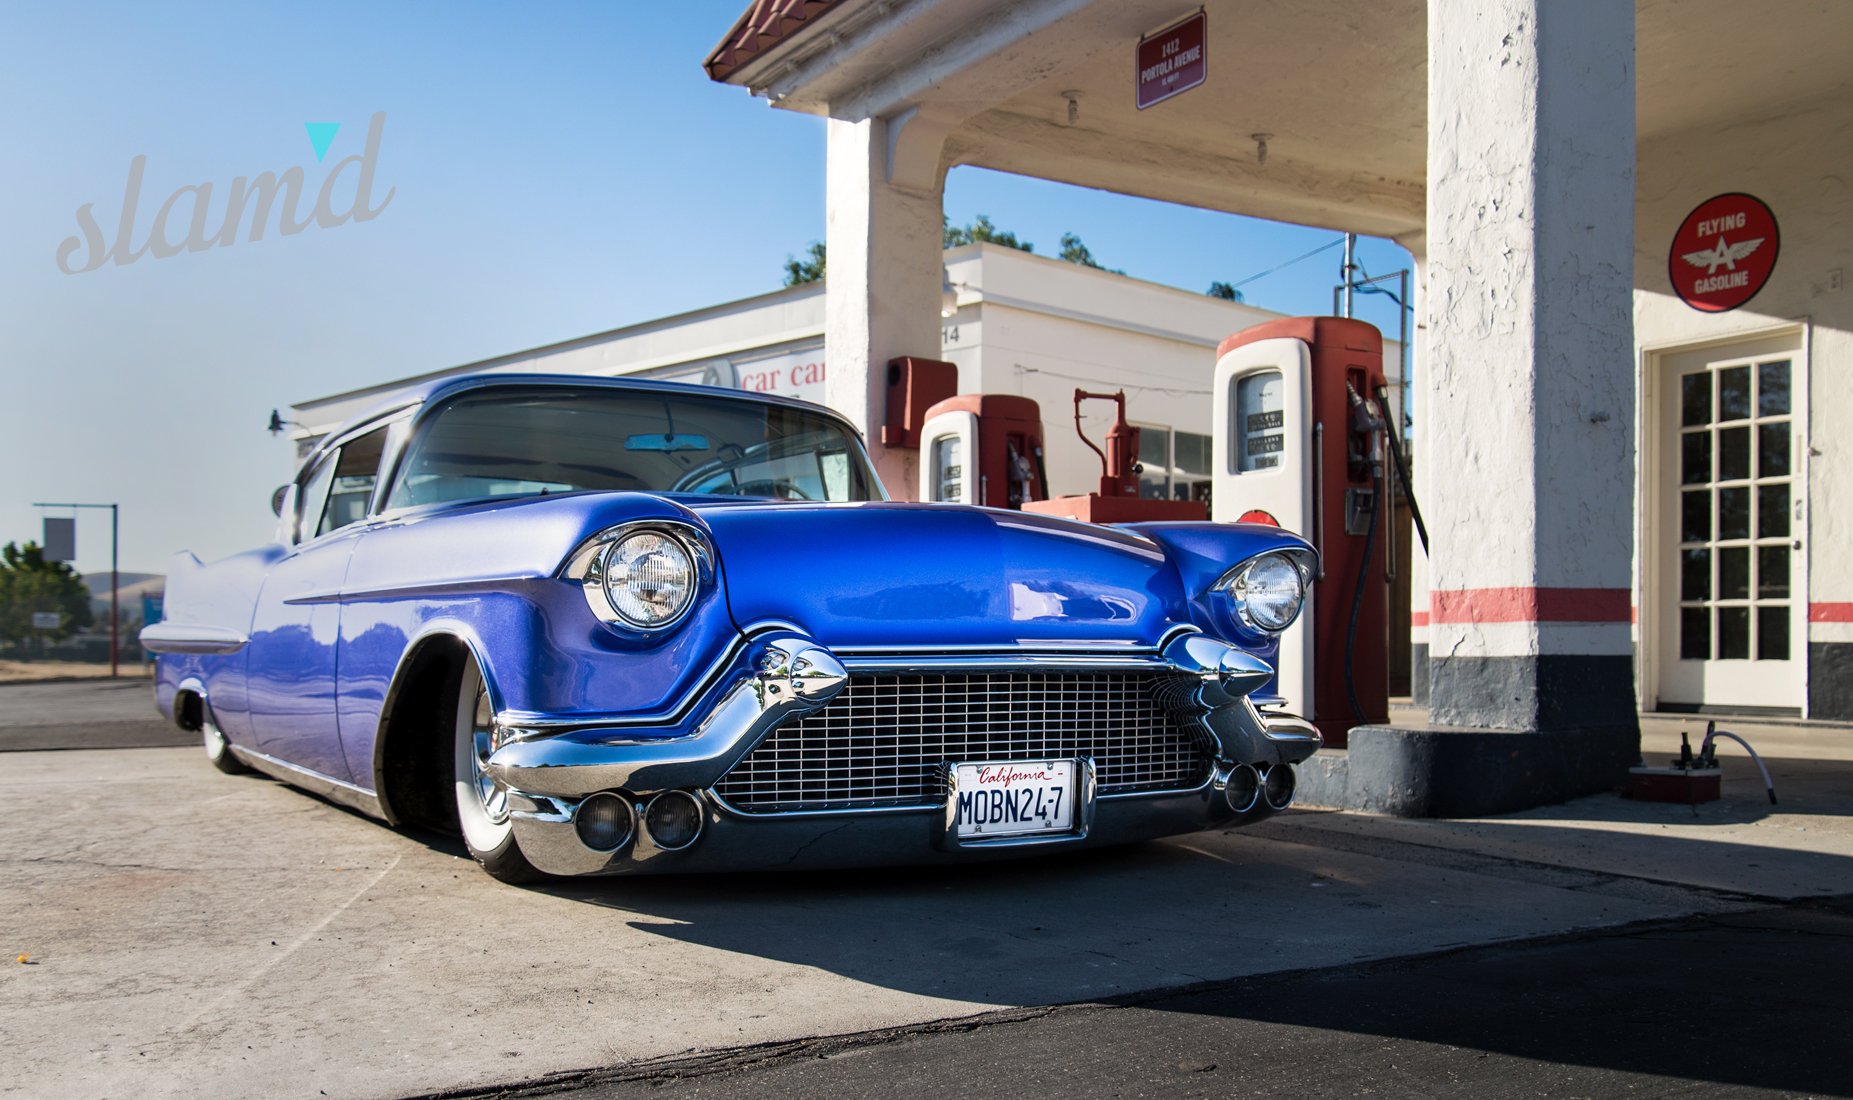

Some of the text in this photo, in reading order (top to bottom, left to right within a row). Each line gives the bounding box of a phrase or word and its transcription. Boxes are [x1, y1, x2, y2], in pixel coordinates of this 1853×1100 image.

[1162, 38, 1180, 58] 1412
[1141, 58, 1173, 84] PORTOLA
[1174, 44, 1201, 69] AVENUE
[1698, 212, 1746, 238] FLYING
[1694, 271, 1749, 294] GASOLINE
[741, 369, 781, 393] car
[979, 766, 1053, 788] California
[958, 786, 1063, 825] MOBN24-7
